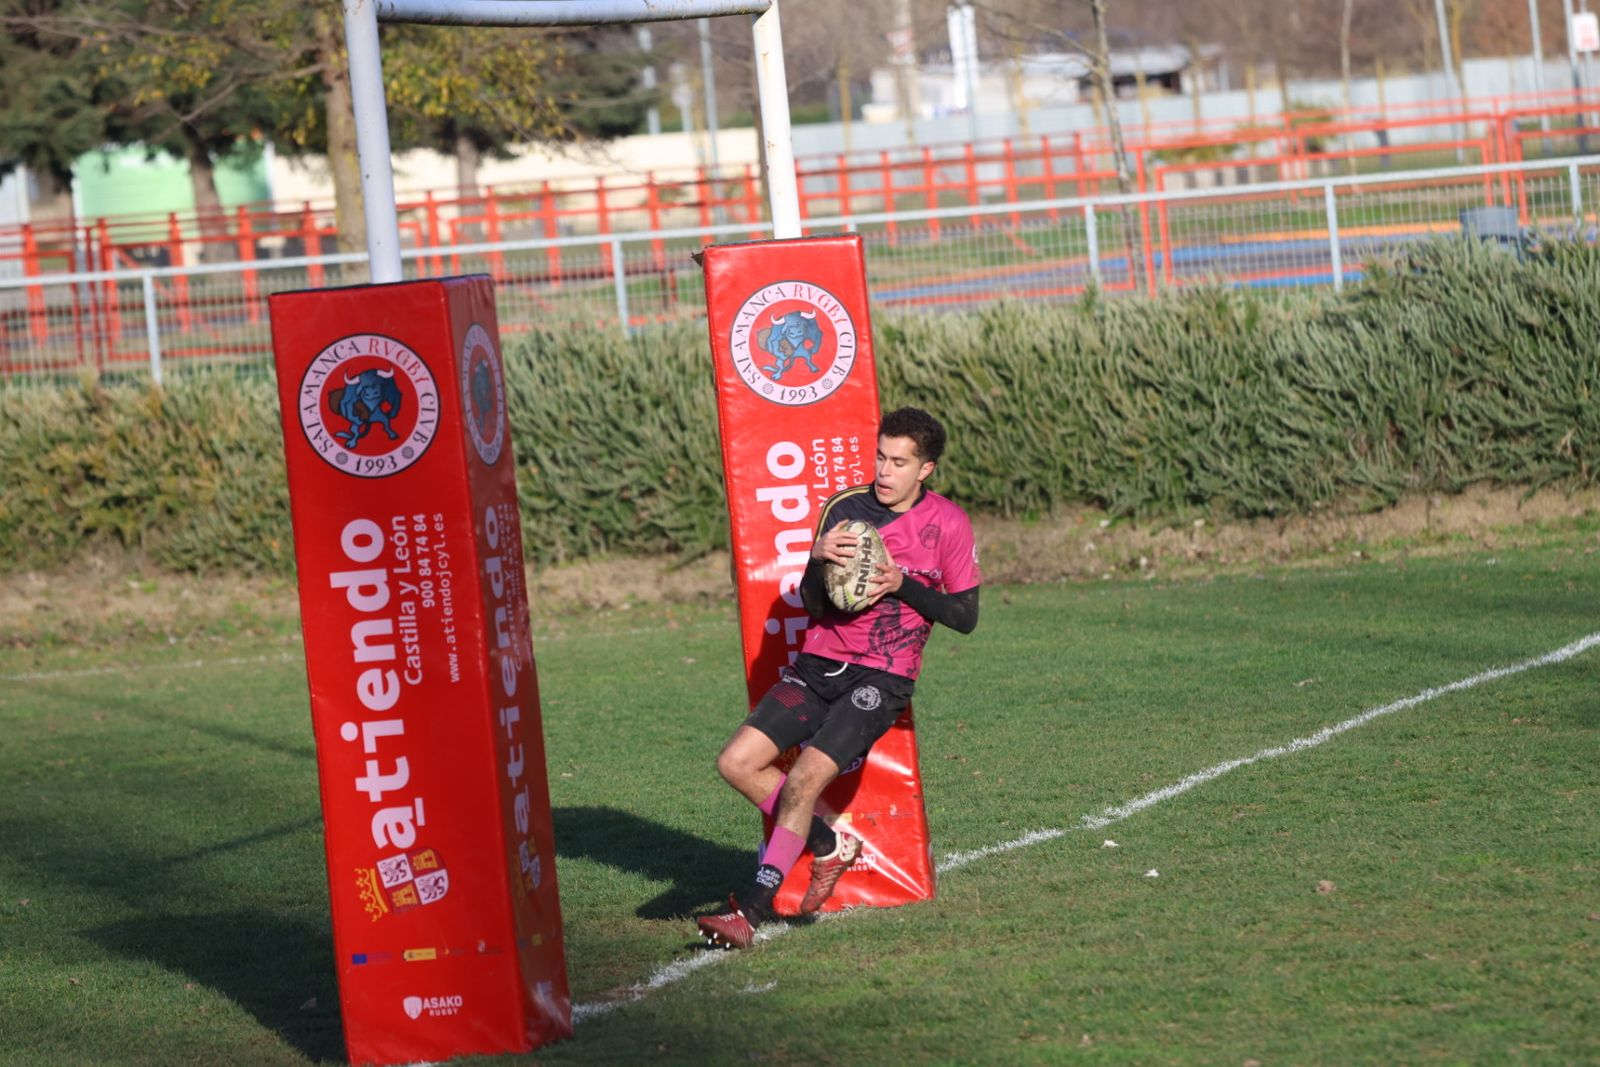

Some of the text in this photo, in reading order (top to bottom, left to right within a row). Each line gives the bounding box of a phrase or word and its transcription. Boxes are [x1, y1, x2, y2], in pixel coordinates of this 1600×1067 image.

[735, 286, 786, 384] SALAMANCA
[303, 340, 361, 454] SALAMANCA
[780, 386, 818, 402] 1993
[355, 455, 398, 473] 1993
[810, 439, 829, 489] León
[831, 437, 844, 452] 84
[833, 456, 846, 472] 74
[413, 513, 435, 608] 900 84 74 84
[756, 441, 813, 679] iendo
[854, 536, 872, 597] RHINO
[390, 516, 423, 685] Castilla y León
[433, 513, 461, 683] www.atiendojcyl.es
[329, 518, 425, 849] atiendo
[423, 995, 463, 1009] ASAKO
[429, 1008, 458, 1017] RUGBY
